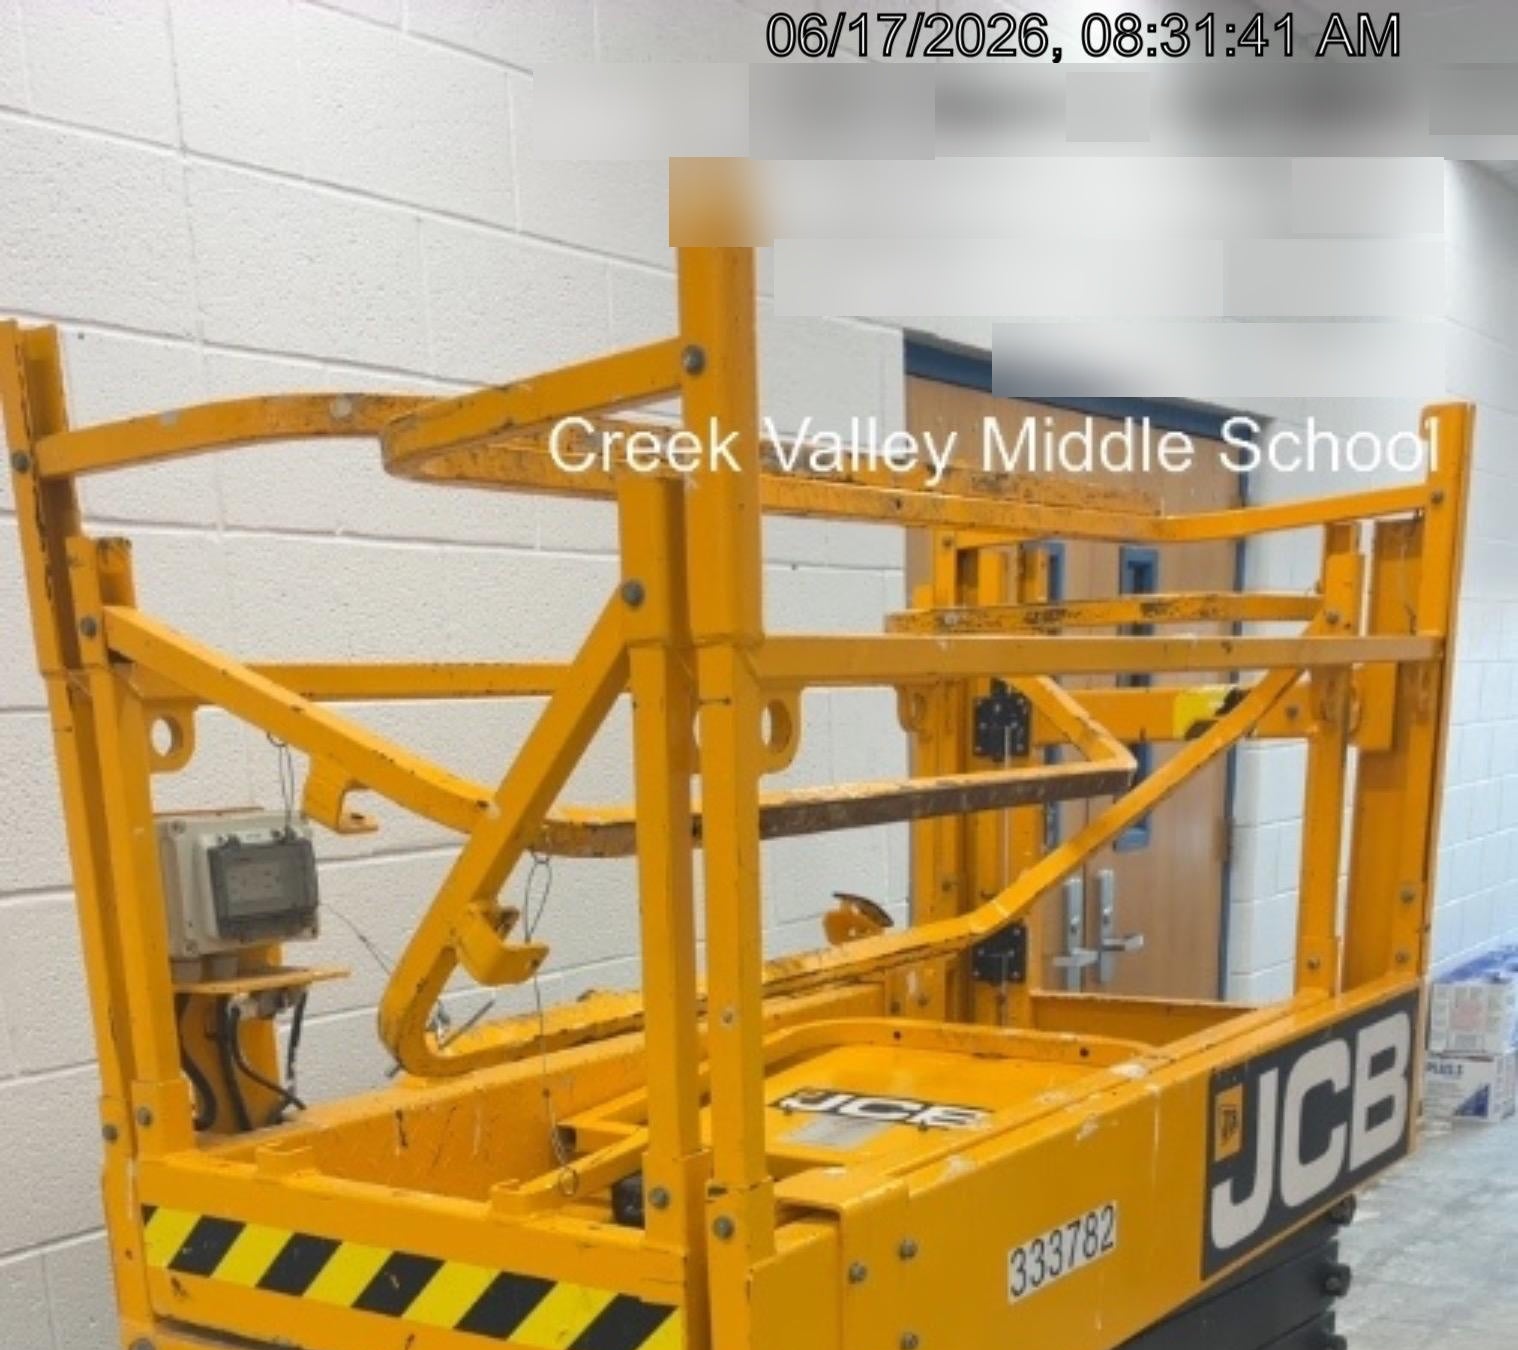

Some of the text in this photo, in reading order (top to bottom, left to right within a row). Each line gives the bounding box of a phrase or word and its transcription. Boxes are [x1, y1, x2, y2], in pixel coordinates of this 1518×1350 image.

[779, 1094, 990, 1130] JCB
[1211, 1011, 1412, 1250] JCB
[1010, 1204, 1114, 1297] 333782
